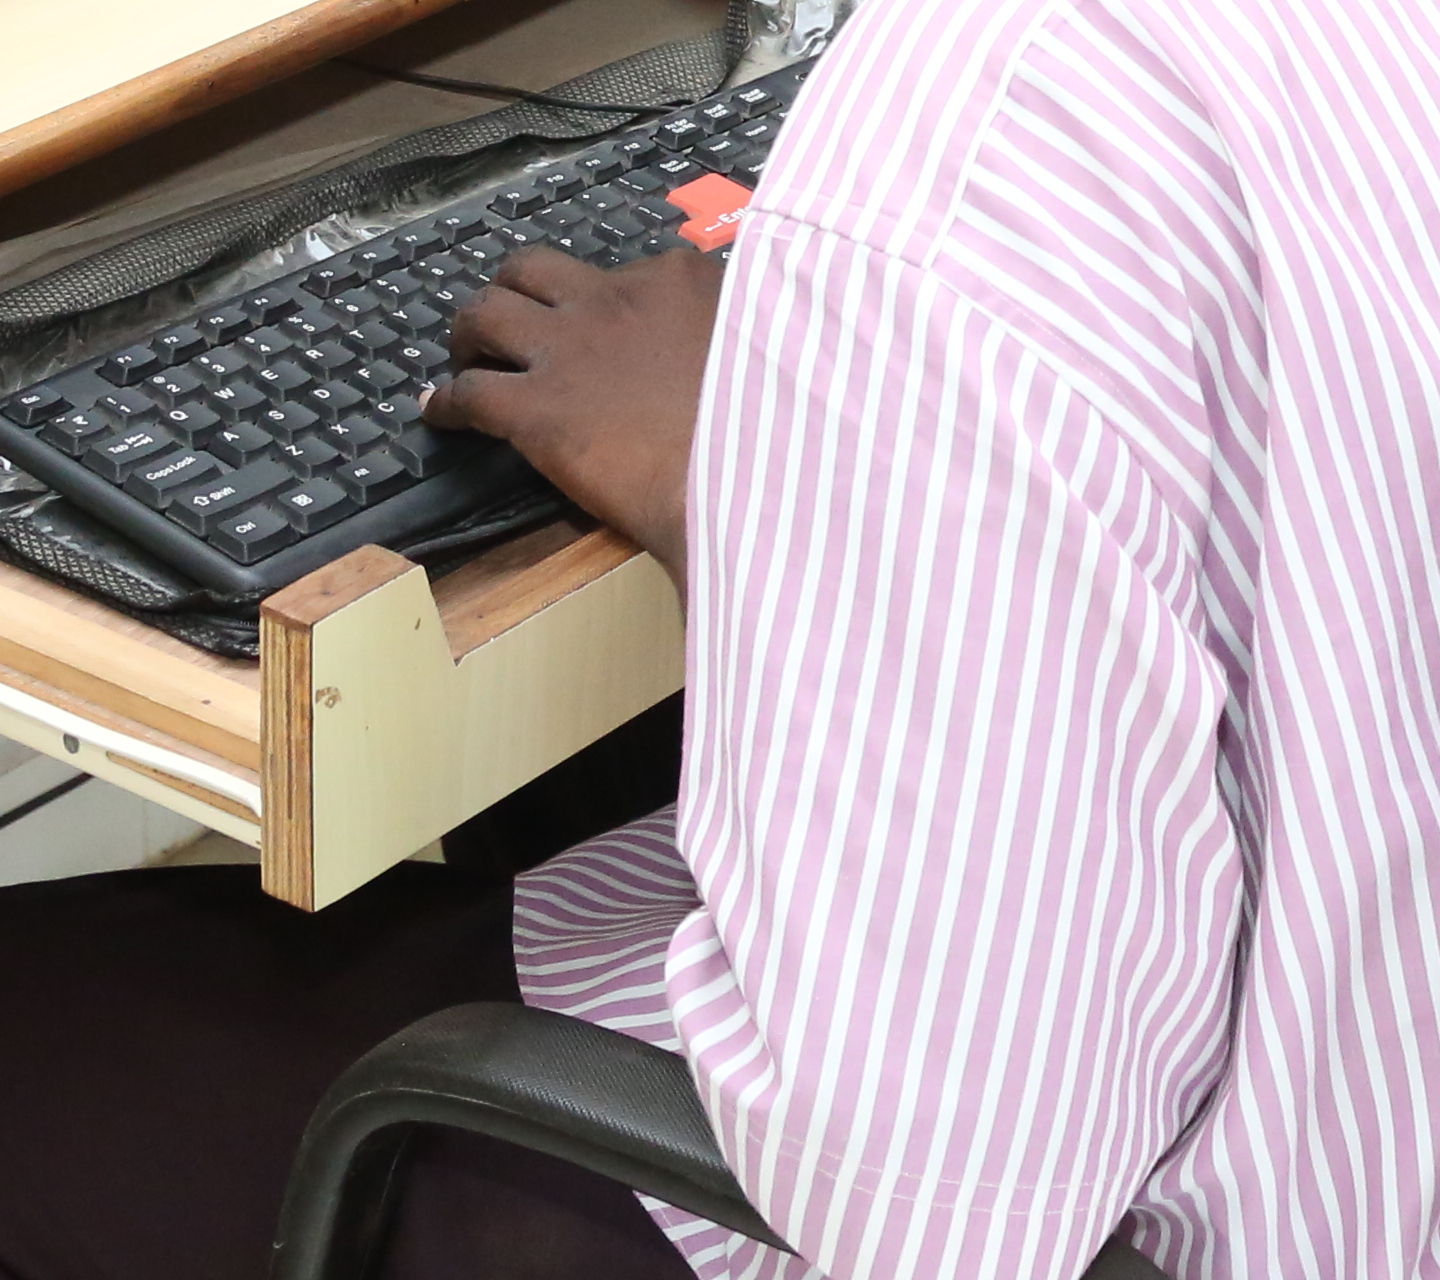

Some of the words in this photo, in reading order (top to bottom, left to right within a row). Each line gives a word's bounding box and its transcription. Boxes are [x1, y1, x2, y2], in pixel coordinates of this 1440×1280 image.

[718, 205, 751, 225] Ent
[260, 369, 279, 381] E
[214, 386, 236, 400] W
[313, 388, 331, 399] D
[169, 410, 189, 421] Q
[268, 409, 285, 421] S
[331, 423, 350, 436] X
[223, 431, 240, 442] A
[108, 443, 130, 455] Tab
[146, 466, 172, 481] Caps
[172, 455, 197, 472] Lock
[209, 485, 237, 501] Shift
[235, 521, 257, 534] Ctrl
